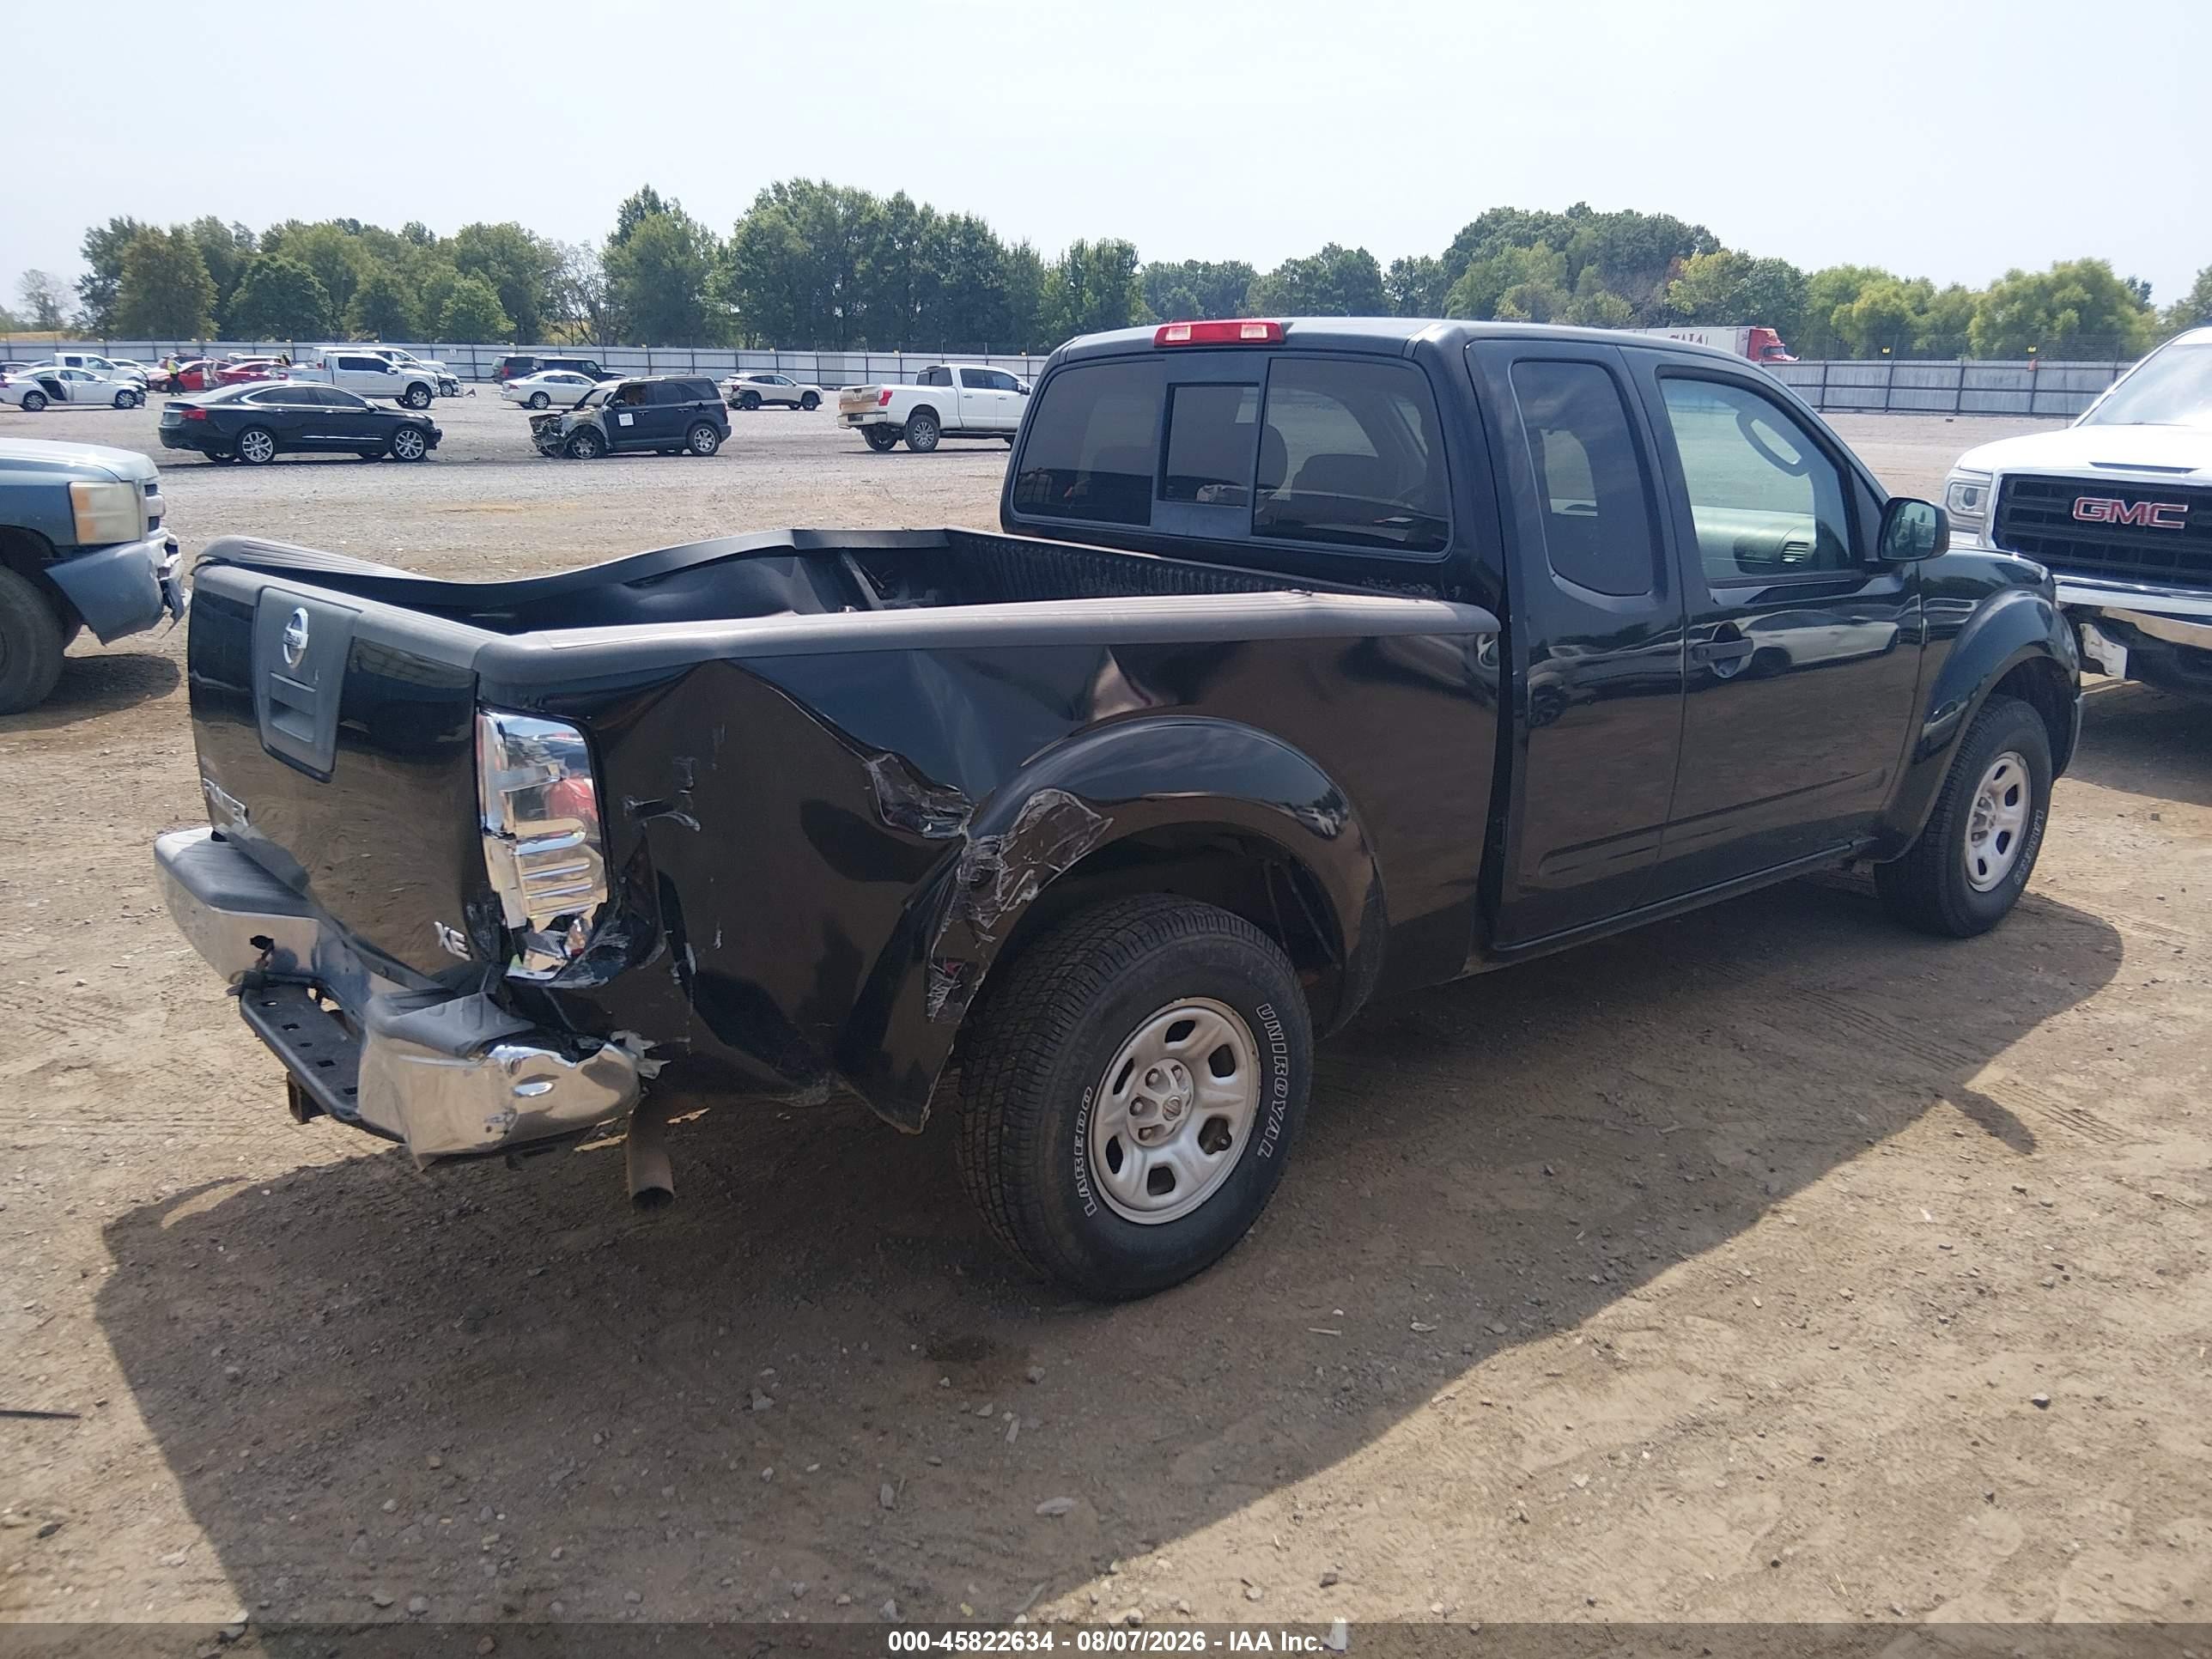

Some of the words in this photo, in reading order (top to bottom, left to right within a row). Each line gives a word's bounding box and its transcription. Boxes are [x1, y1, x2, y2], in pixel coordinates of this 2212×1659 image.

[2073, 496, 2188, 529] GMC
[434, 921, 471, 961] XE
[1255, 1003, 1287, 1158] UNIROYAL
[1073, 1086, 1097, 1217] LAREDO
